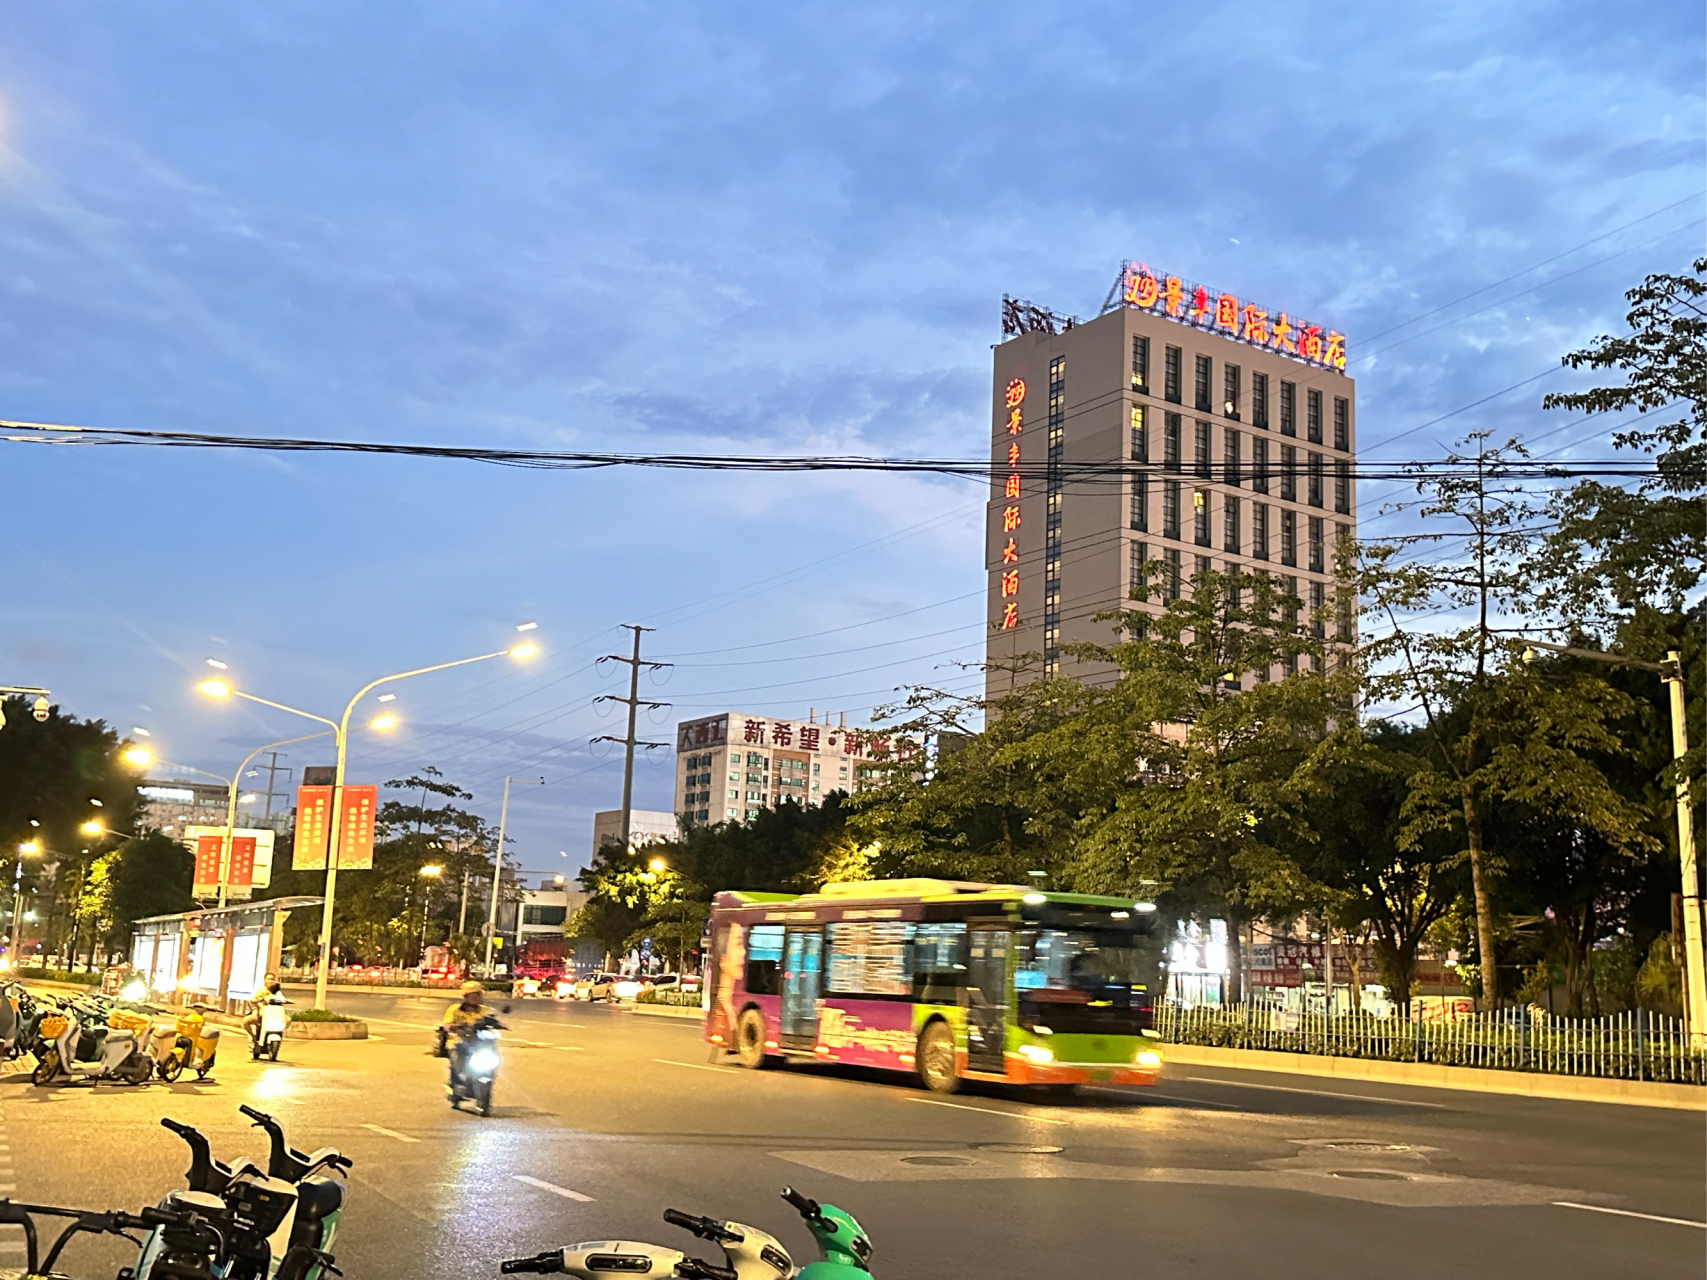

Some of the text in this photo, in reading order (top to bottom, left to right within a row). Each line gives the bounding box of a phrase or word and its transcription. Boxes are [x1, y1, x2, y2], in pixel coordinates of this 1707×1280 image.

[1158, 276, 1346, 371] 景丰国际大酒店
[1002, 407, 1023, 630] 景丰国际大酒店
